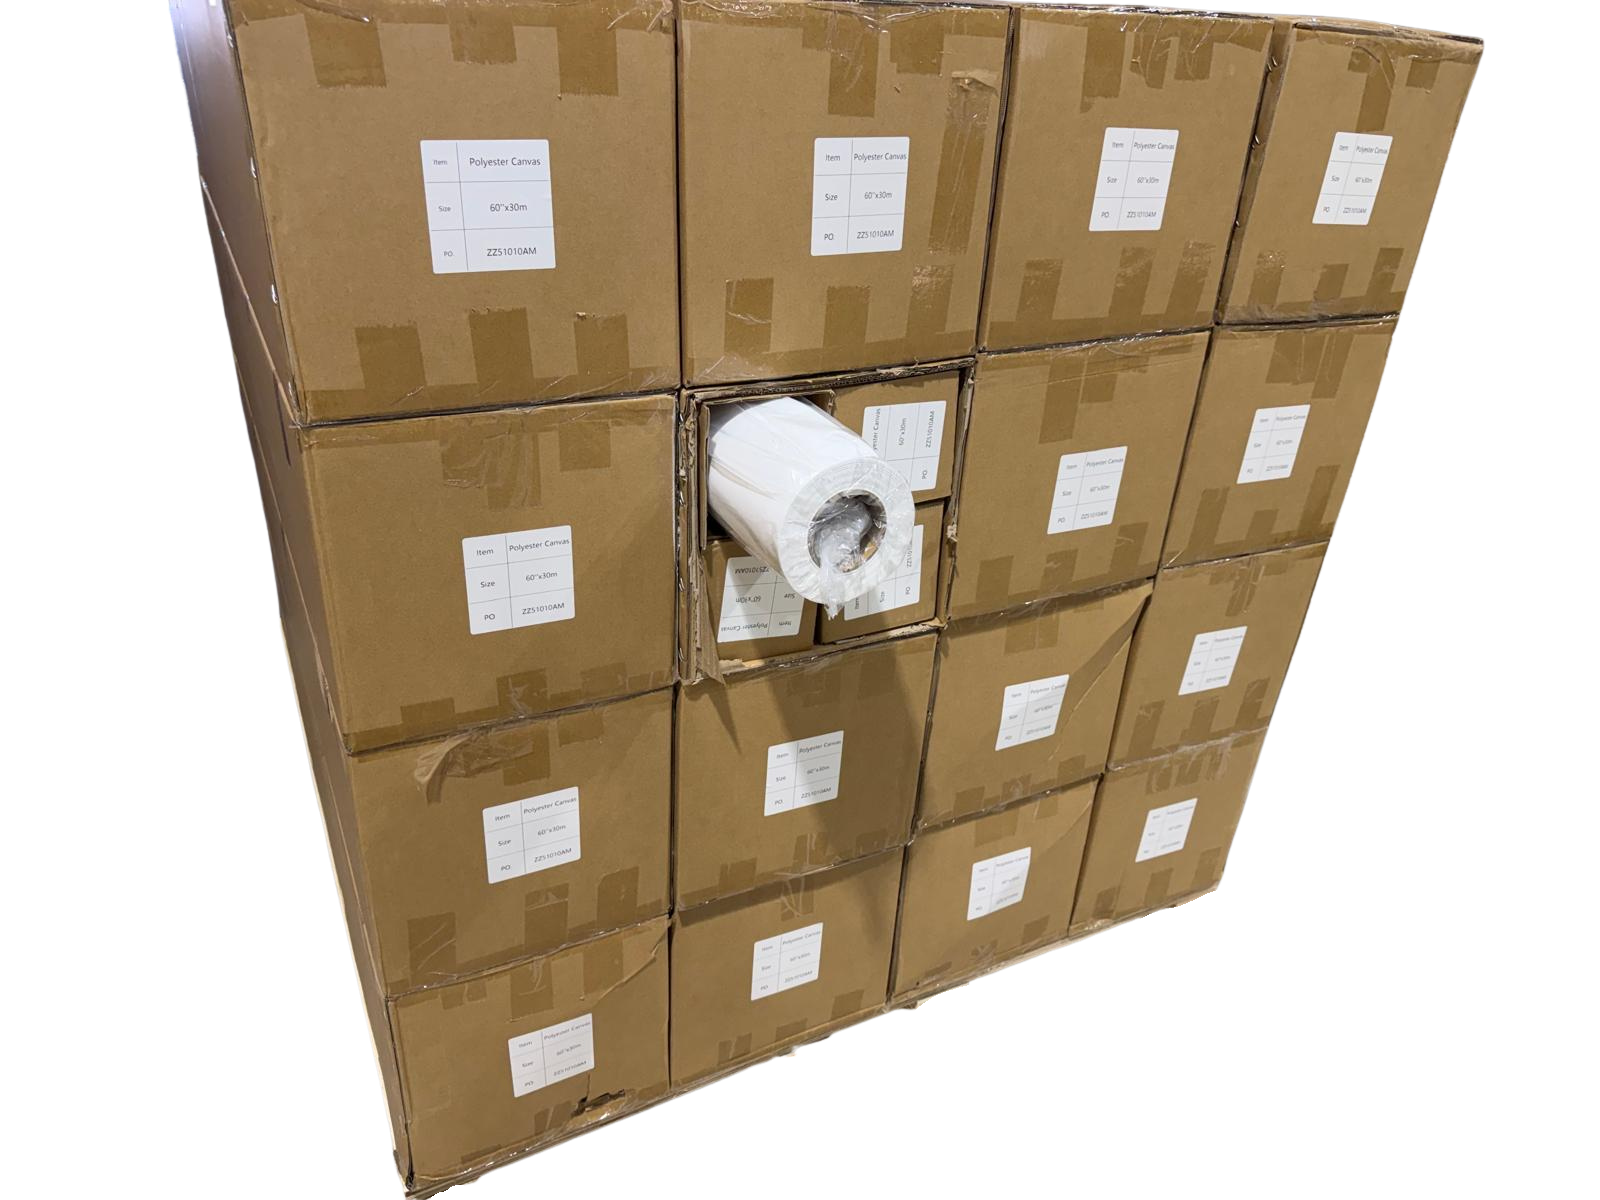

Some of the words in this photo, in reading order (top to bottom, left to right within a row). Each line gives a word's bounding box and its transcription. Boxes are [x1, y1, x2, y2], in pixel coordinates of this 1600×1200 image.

[1133, 142, 1158, 150] Polyester
[1158, 142, 1175, 150] Canvas
[433, 158, 448, 166] Item
[468, 156, 510, 168] Polyester
[511, 157, 542, 166] Canvas
[825, 154, 841, 162] Item
[853, 153, 884, 163] Polyester
[884, 152, 907, 161] Canvas
[1106, 176, 1118, 184] Size
[824, 193, 838, 202] Size
[438, 205, 452, 213] Size
[824, 233, 834, 241] PO
[856, 230, 895, 240] ZZ51010AM
[486, 247, 537, 257] ZZ51010AM
[922, 470, 928, 480] PO
[926, 410, 935, 449] ZZ51010AM
[476, 548, 494, 556] Item
[508, 541, 543, 553] Polyester
[544, 538, 570, 548] Canvas
[480, 580, 496, 588] Size
[905, 587, 911, 595] PO
[484, 613, 496, 621] PO
[522, 602, 565, 615] ZZ51010AM
[741, 622, 769, 631] Polyester
[494, 813, 511, 822] Item
[523, 802, 553, 815] Polyester
[554, 796, 577, 807] Canvas
[498, 839, 512, 847] Size
[500, 864, 511, 872] PO
[534, 848, 572, 863] ZZ51010AM
